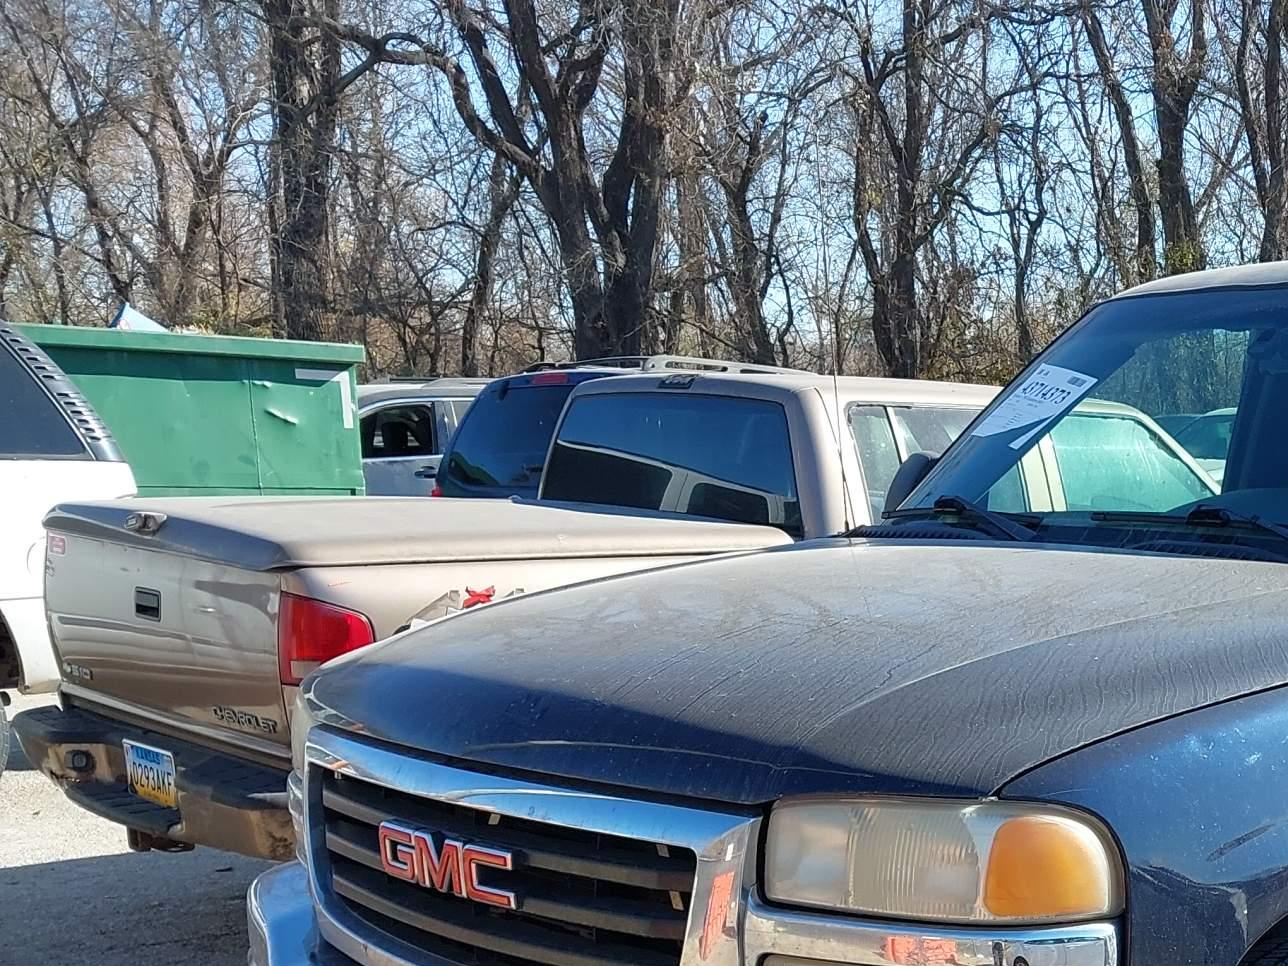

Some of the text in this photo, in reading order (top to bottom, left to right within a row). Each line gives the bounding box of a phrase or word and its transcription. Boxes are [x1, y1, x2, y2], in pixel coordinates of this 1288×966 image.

[1021, 380, 1071, 405] 43714373
[212, 705, 278, 733] CHEVROLET
[379, 820, 517, 910] GMC
